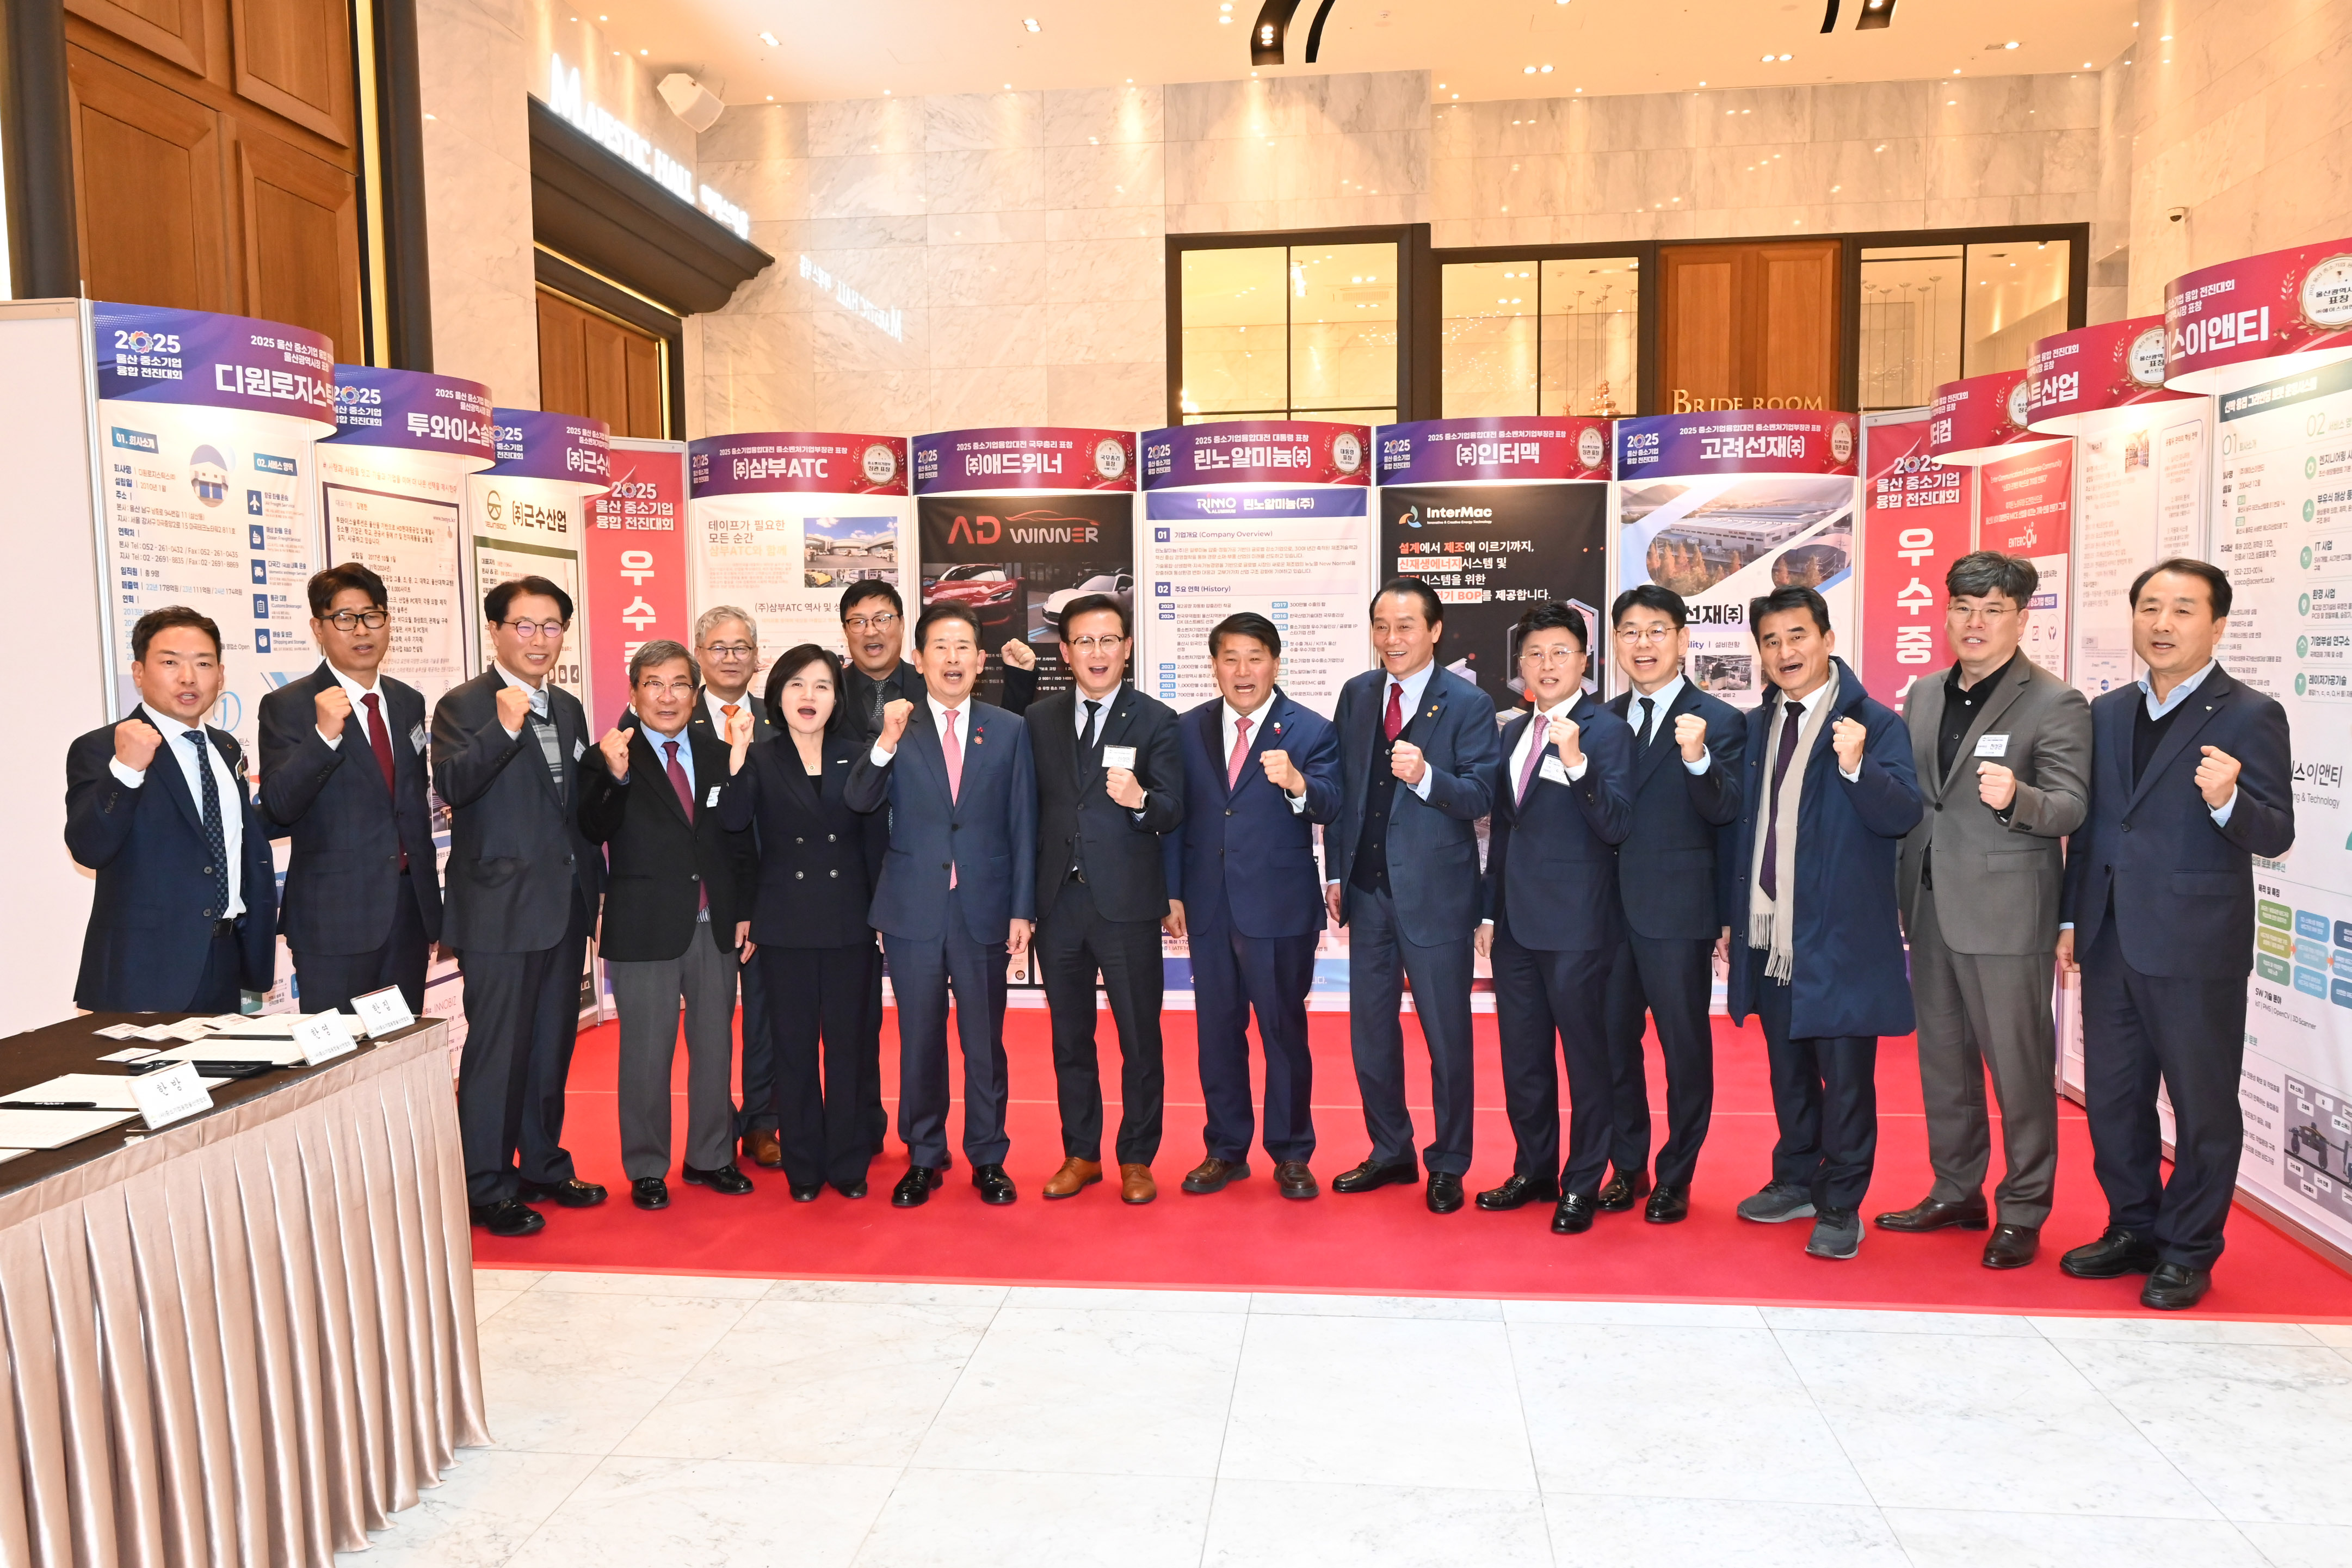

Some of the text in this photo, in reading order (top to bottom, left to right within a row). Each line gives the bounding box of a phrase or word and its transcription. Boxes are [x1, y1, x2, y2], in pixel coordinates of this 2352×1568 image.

[655, 149, 695, 204] HALL
[2185, 279, 2234, 302] 융합 전진대회
[2329, 295, 2349, 305] 표창
[2188, 301, 2202, 314] 표창
[115, 330, 180, 354] 2025
[251, 335, 275, 348] 2025
[277, 339, 293, 351] 울산
[294, 342, 318, 357] 중소기업
[2053, 344, 2079, 357] 전진대회
[116, 354, 182, 369] 울산 중소기업
[2044, 361, 2054, 371] 표창
[116, 366, 182, 380] 융합 전진대회
[436, 388, 454, 399] 2025
[1948, 391, 1968, 403] 전진대회
[1752, 396, 1822, 410] ROOM
[349, 406, 381, 417] 중소기업
[349, 416, 382, 427] 전진대회
[1699, 425, 1754, 433] 중소기업융합대전
[129, 435, 155, 449] 회사소개
[1195, 436, 1212, 445] 2025
[1214, 435, 1271, 443] 중소기업융합대전
[1428, 433, 1443, 442] 2025
[1444, 431, 1497, 440] 중소기업융합대전
[1498, 430, 1554, 439] 중소벤처기업부장관
[1627, 433, 1658, 449] 2025
[731, 447, 775, 455] 중소기업융합대전
[973, 441, 1027, 449] 중소기업융합대전
[1059, 441, 1073, 449] 표창
[1384, 439, 1410, 454] 2025
[1700, 436, 1805, 459] 고려선재(주)
[2223, 434, 2237, 455] 01
[1148, 445, 1170, 459] 2025
[1194, 446, 1311, 470] 린노알미늄(주)
[1456, 442, 1540, 466] (주)인터맥
[1638, 448, 1658, 456] 중소기업
[114, 464, 132, 474] 회사명
[733, 458, 828, 480] (주)삼부ATC
[966, 453, 1062, 476] (주)애드위너
[115, 477, 132, 487] 설립일
[1876, 472, 1959, 493] 울산 중소기업
[612, 481, 657, 499] 2025
[1243, 497, 1314, 510] 린노알미늄(주)
[1876, 489, 1959, 509] 융합 전진대회
[596, 500, 674, 516] 울산 중소기업
[1427, 507, 1492, 518] InterMac
[596, 516, 674, 531] 융합 전진대회
[708, 520, 785, 532] 테이프가 필요한
[947, 516, 1098, 545] AD WINNER
[1200, 532, 1235, 540] (Company
[709, 532, 754, 544] 모든 순간
[709, 545, 762, 557] 삼부ATC와
[1399, 540, 1534, 554] 설계에서 제조에 이르기까지,
[2315, 540, 2332, 551] IT 사업
[1399, 557, 1507, 570] 신재생에너지시스템 및
[1465, 573, 1486, 585] 위한
[1458, 589, 1551, 601] BOP를 제공합니다.
[2313, 589, 2335, 599] 환경 사업
[755, 602, 831, 613] (주)삼부ATC 역사 및
[2311, 636, 2350, 646] 기업부설 연구소
[2309, 675, 2347, 686] 레이저가공기술
[2307, 793, 2339, 810] Technology
[435, 996, 456, 1012] INNOBIZ
